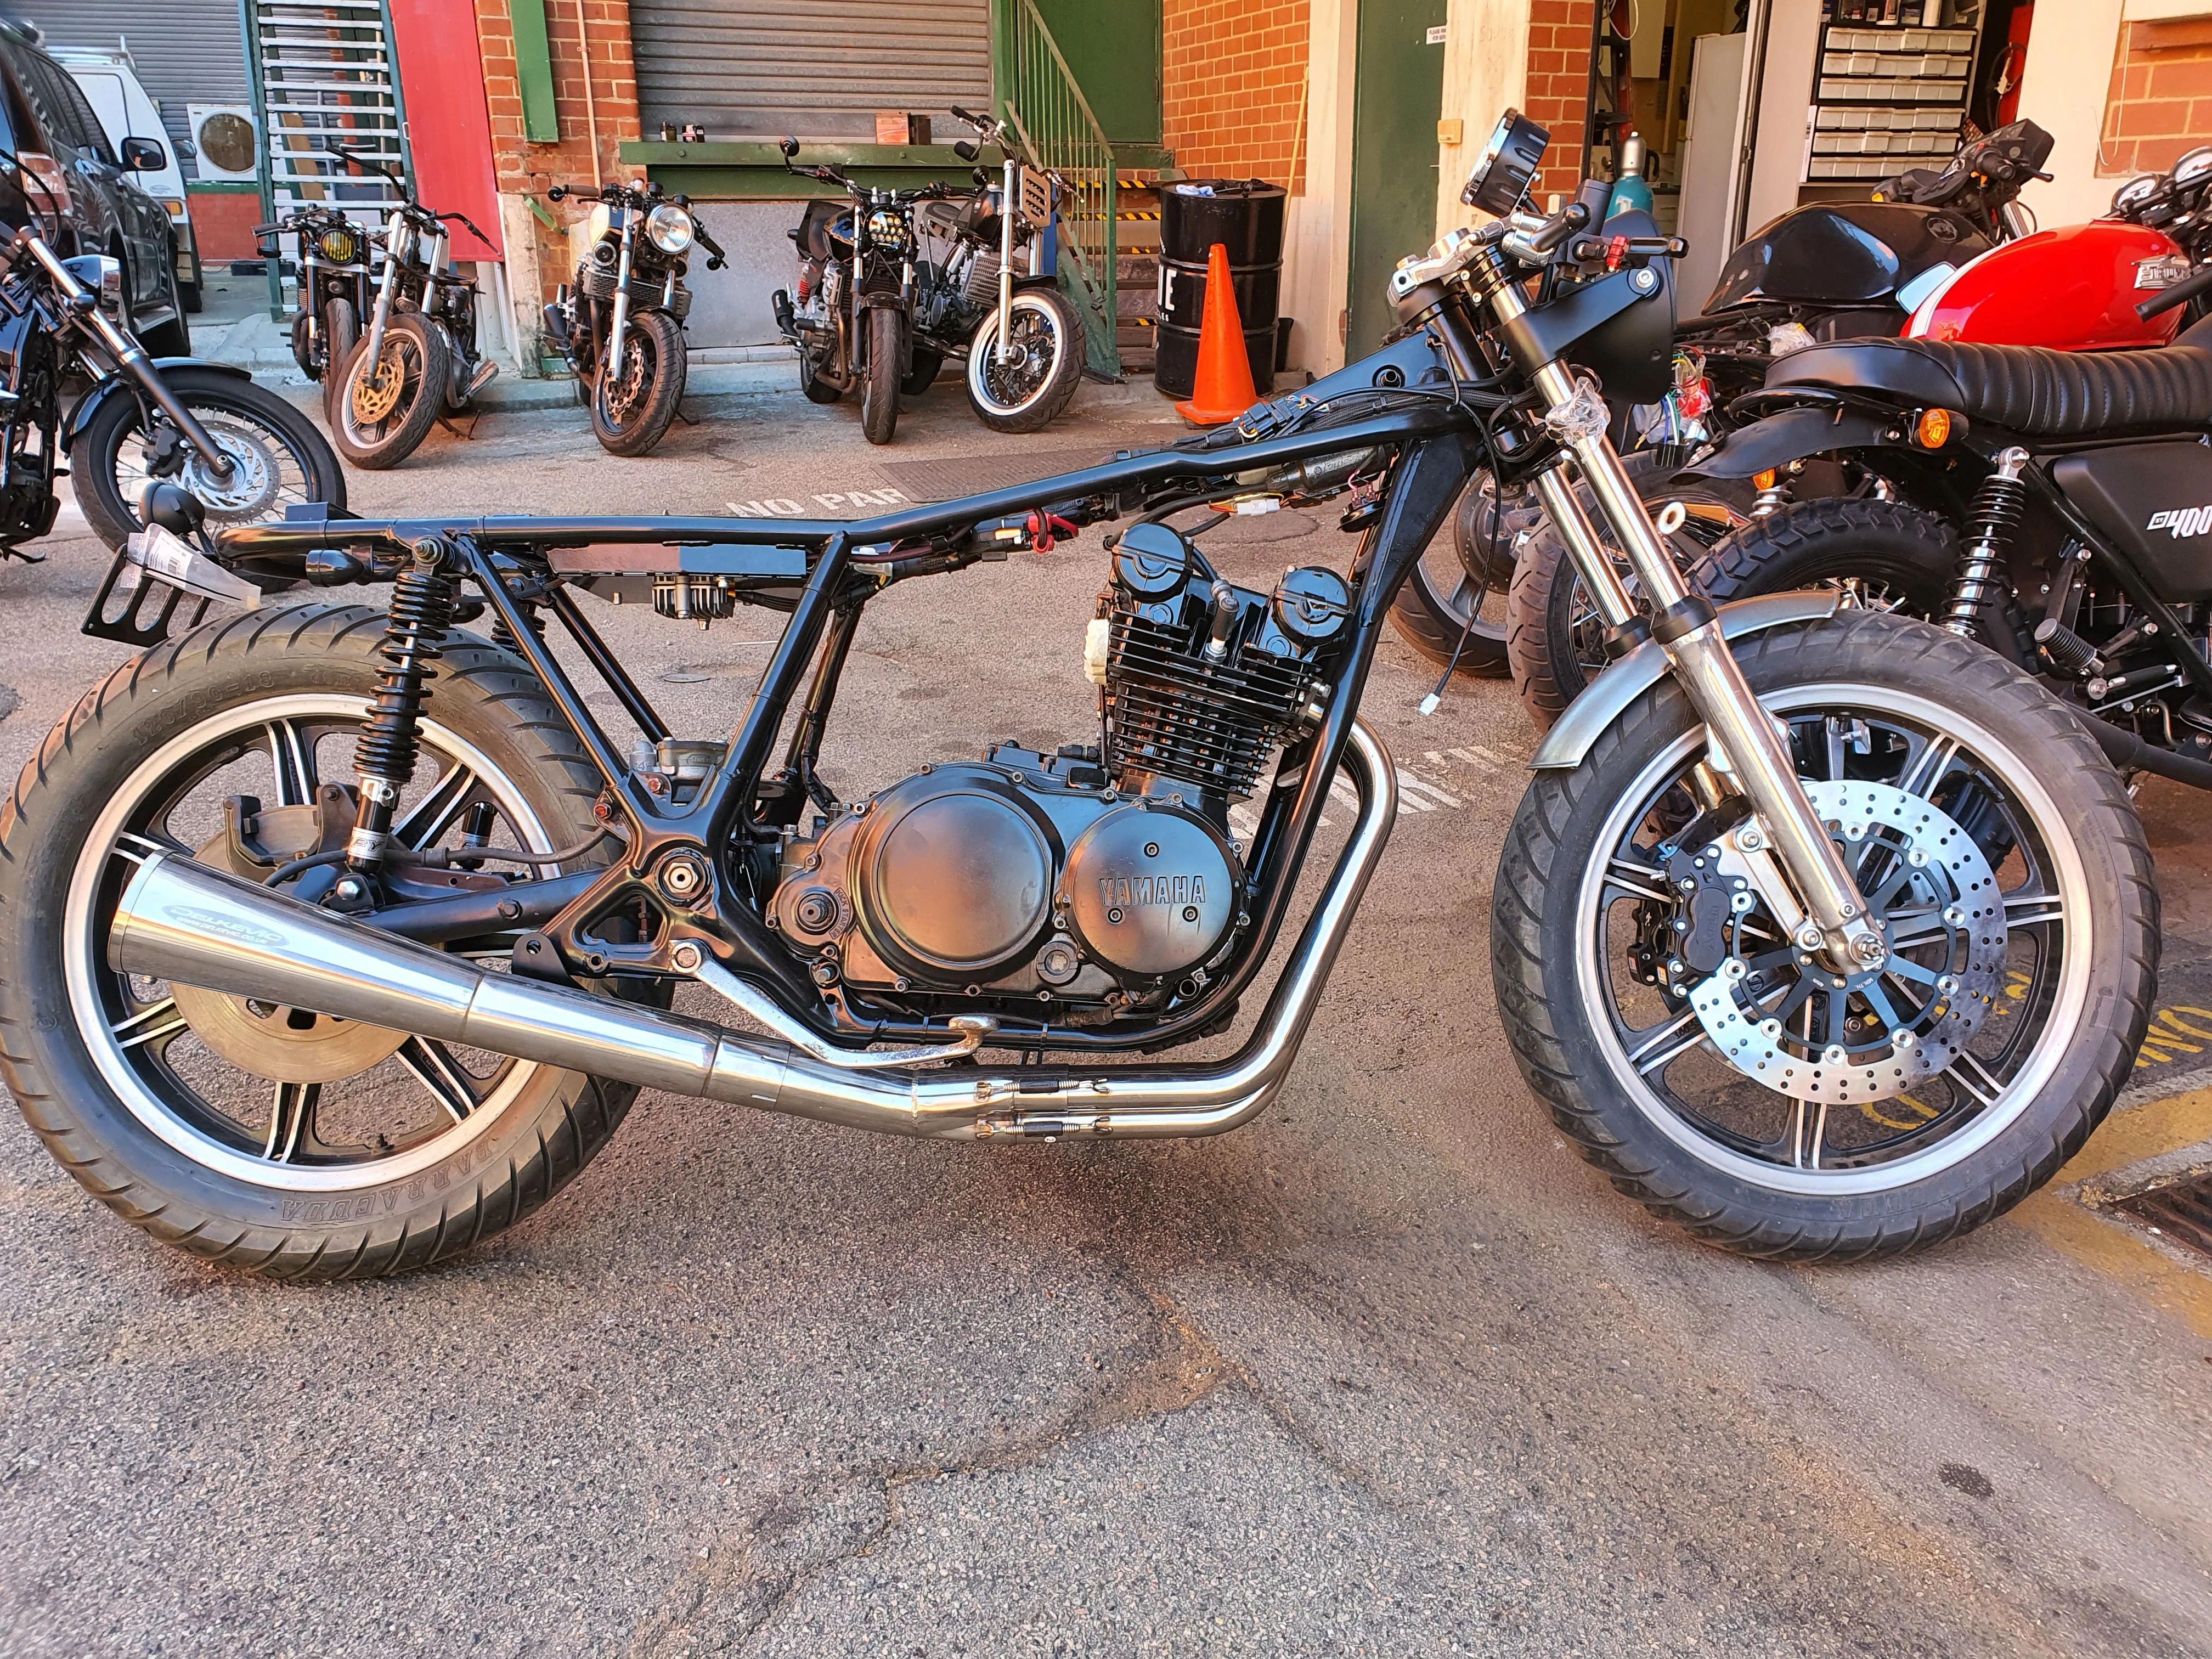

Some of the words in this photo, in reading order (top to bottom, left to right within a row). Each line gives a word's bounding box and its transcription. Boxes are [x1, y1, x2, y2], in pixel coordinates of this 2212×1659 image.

[726, 498, 805, 517] NO
[811, 490, 912, 510] PAR
[836, 889, 849, 907] KICK
[1099, 876, 1206, 906] YAMAHA
[831, 909, 849, 938] STARTER
[281, 1140, 492, 1221] BARRACUDA
